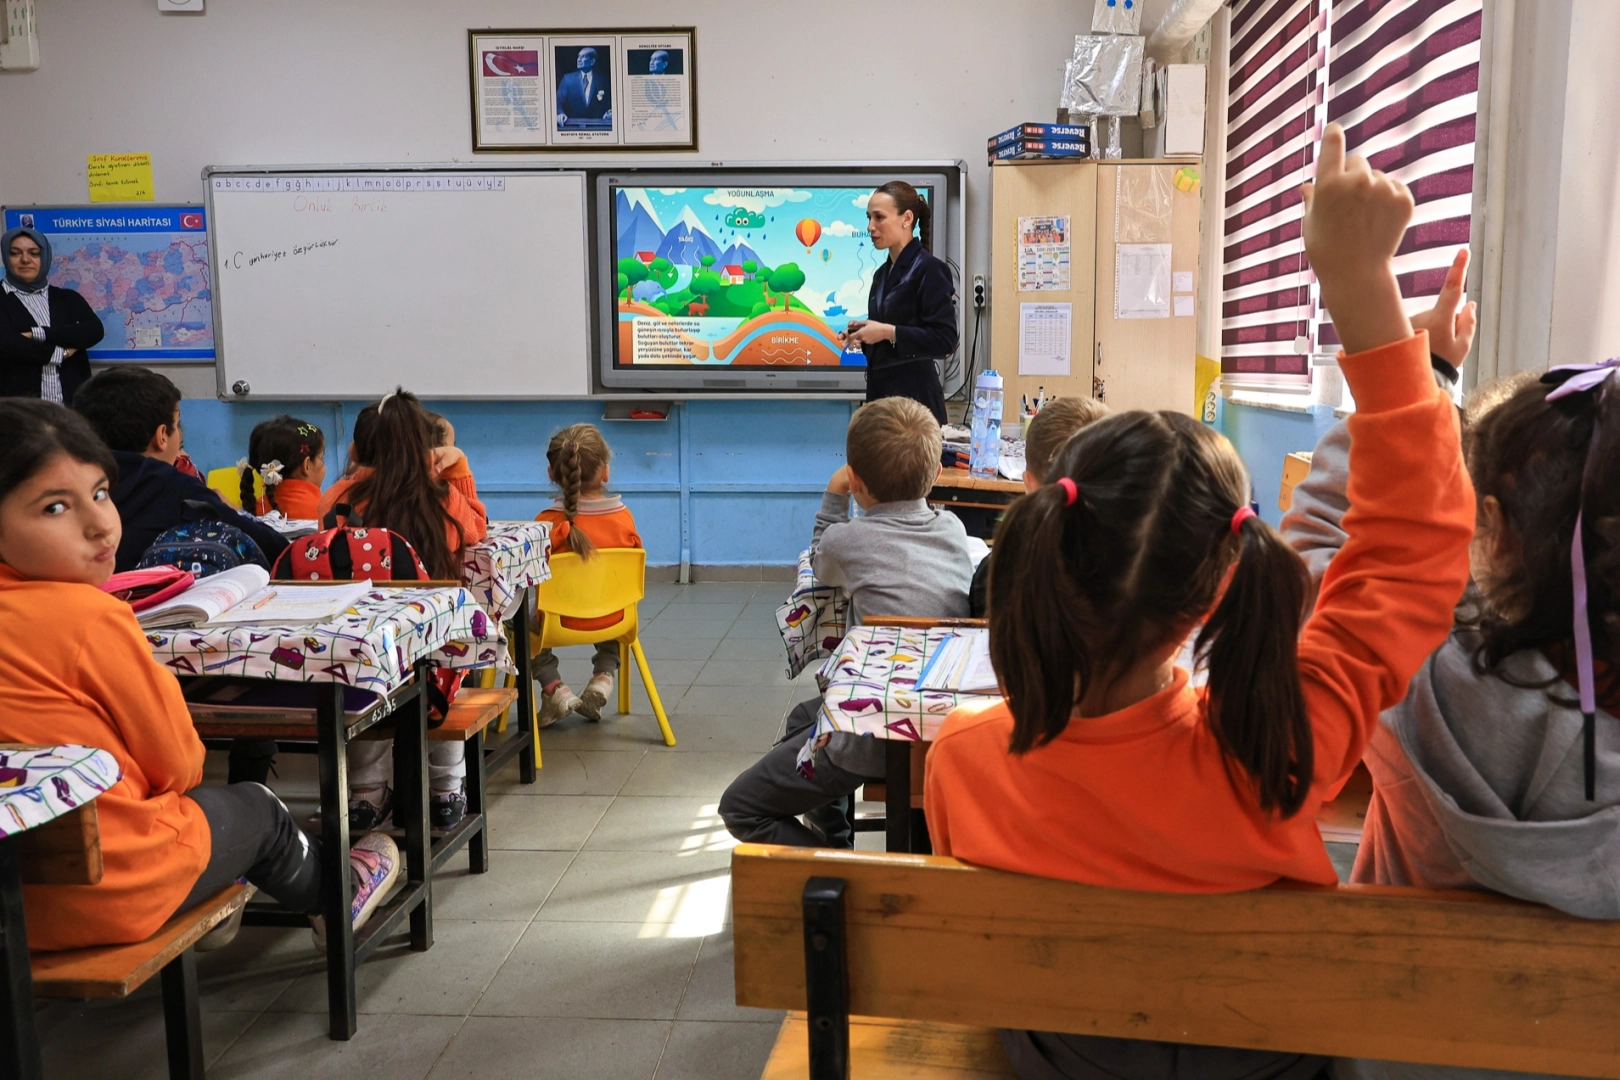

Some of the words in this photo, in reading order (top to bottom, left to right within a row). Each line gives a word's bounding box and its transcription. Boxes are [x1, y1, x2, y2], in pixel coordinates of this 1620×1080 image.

[1051, 126, 1085, 138] Reverse
[1051, 142, 1086, 153] Reverse
[226, 179, 231, 187] b
[256, 179, 260, 187] d
[276, 179, 279, 187] f
[286, 182, 290, 191] g
[296, 179, 300, 191] ğ
[306, 179, 311, 187] h
[346, 179, 350, 187] k
[406, 181, 411, 189] p
[487, 181, 492, 190] y
[727, 190, 774, 199] YOĞUNLAŞMA
[294, 195, 331, 212] Onluk
[352, 196, 387, 212] Birlik
[53, 217, 93, 228] TÜRKİYE
[96, 217, 126, 227] SİYASİ
[128, 216, 171, 226] HARİTASI
[771, 336, 799, 344] BİRİKME
